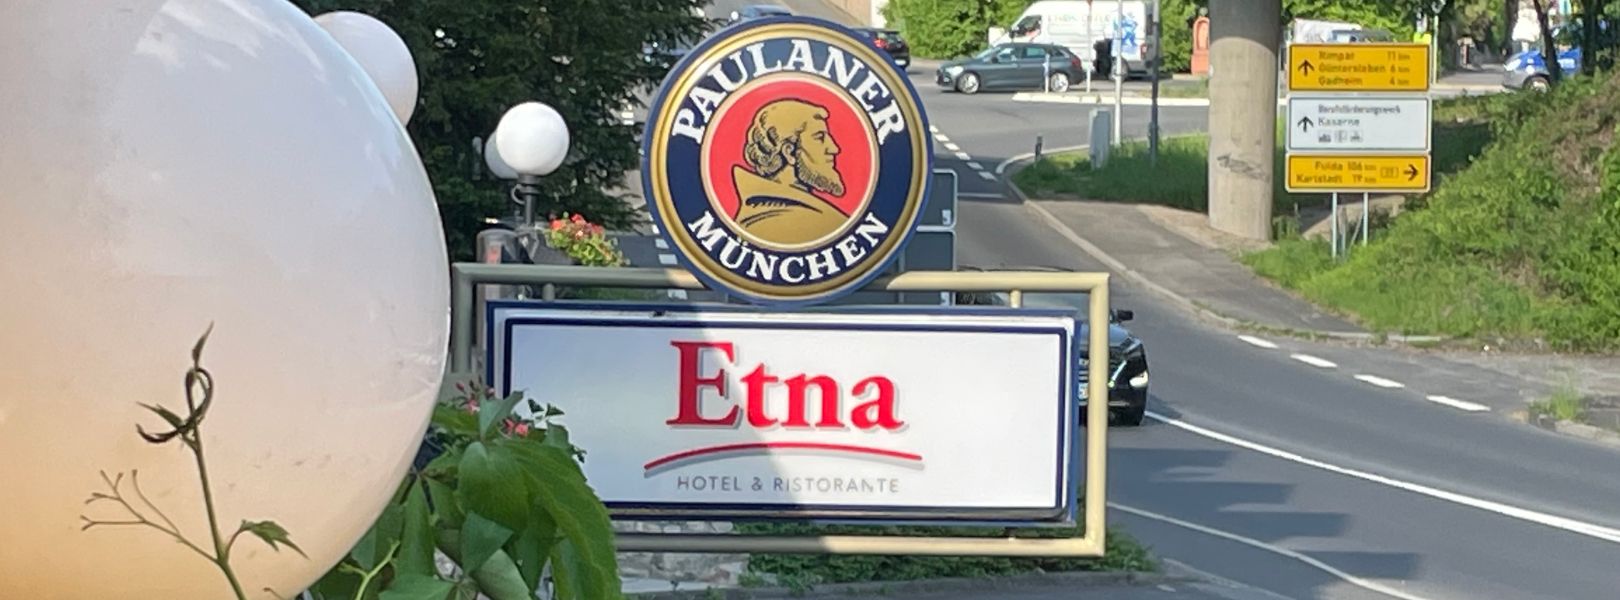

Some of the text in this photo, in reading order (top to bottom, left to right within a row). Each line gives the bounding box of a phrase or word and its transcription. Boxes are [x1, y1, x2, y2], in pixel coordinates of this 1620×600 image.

[1318, 51, 1355, 61] Rimpar
[672, 39, 905, 145] PAULANER
[1318, 117, 1360, 126] Kaserne
[1315, 161, 1343, 171] Fulda
[1296, 173, 1343, 184] Karlstadt
[687, 210, 890, 283] MÜNCHEN
[666, 340, 906, 431] Etna
[677, 475, 899, 493] HOTEL & RISTORANTE
